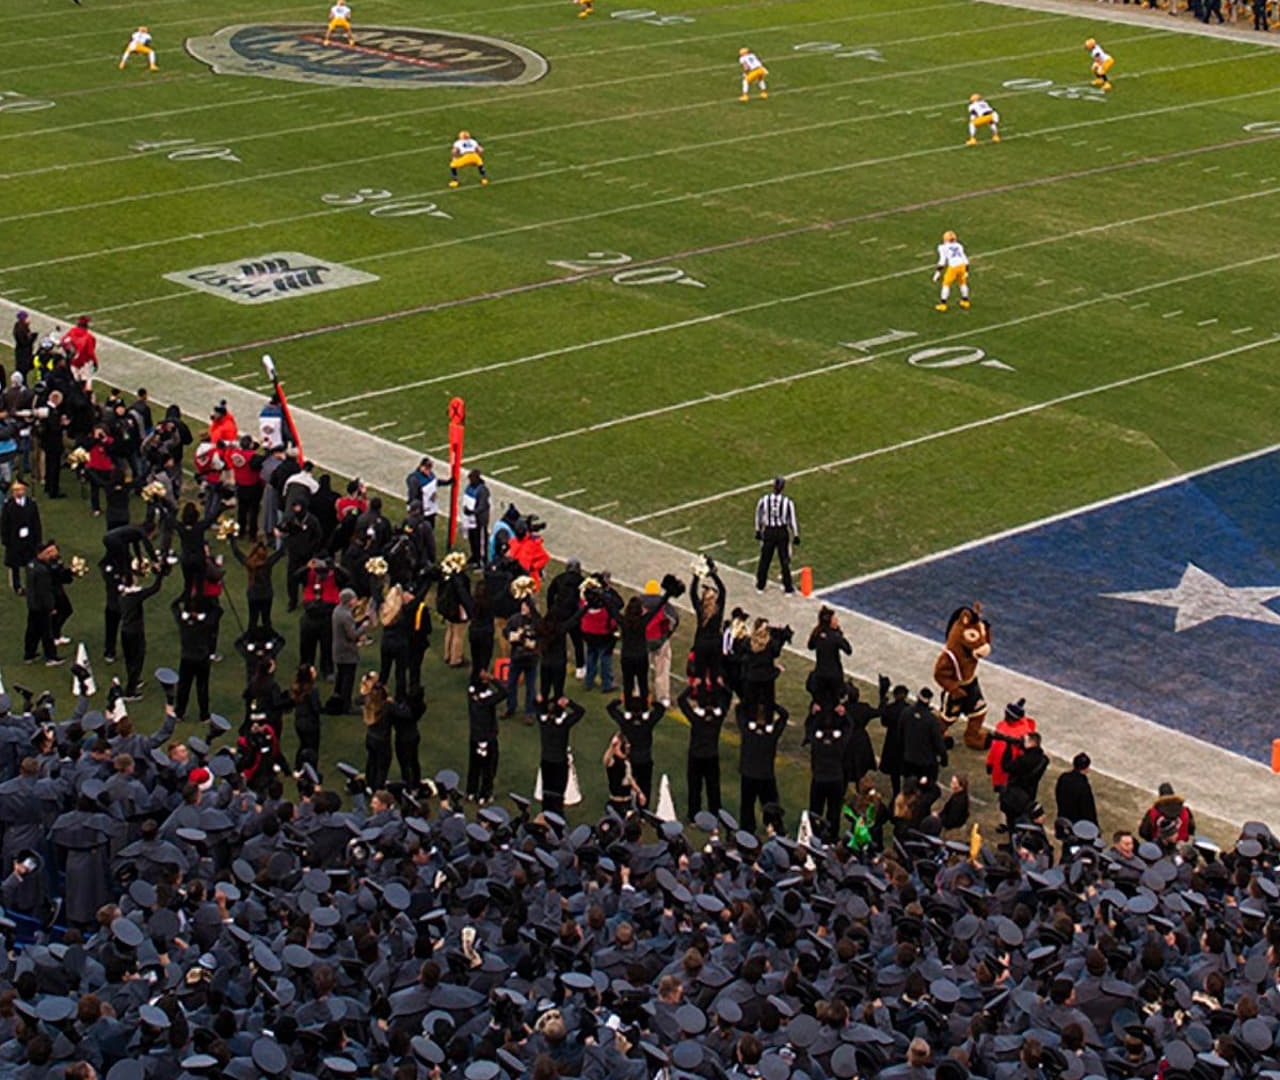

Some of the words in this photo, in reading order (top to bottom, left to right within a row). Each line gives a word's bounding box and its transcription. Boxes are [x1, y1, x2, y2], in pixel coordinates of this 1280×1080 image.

[320, 187, 438, 219] 30
[546, 250, 686, 286] 20
[839, 328, 986, 369] 10
